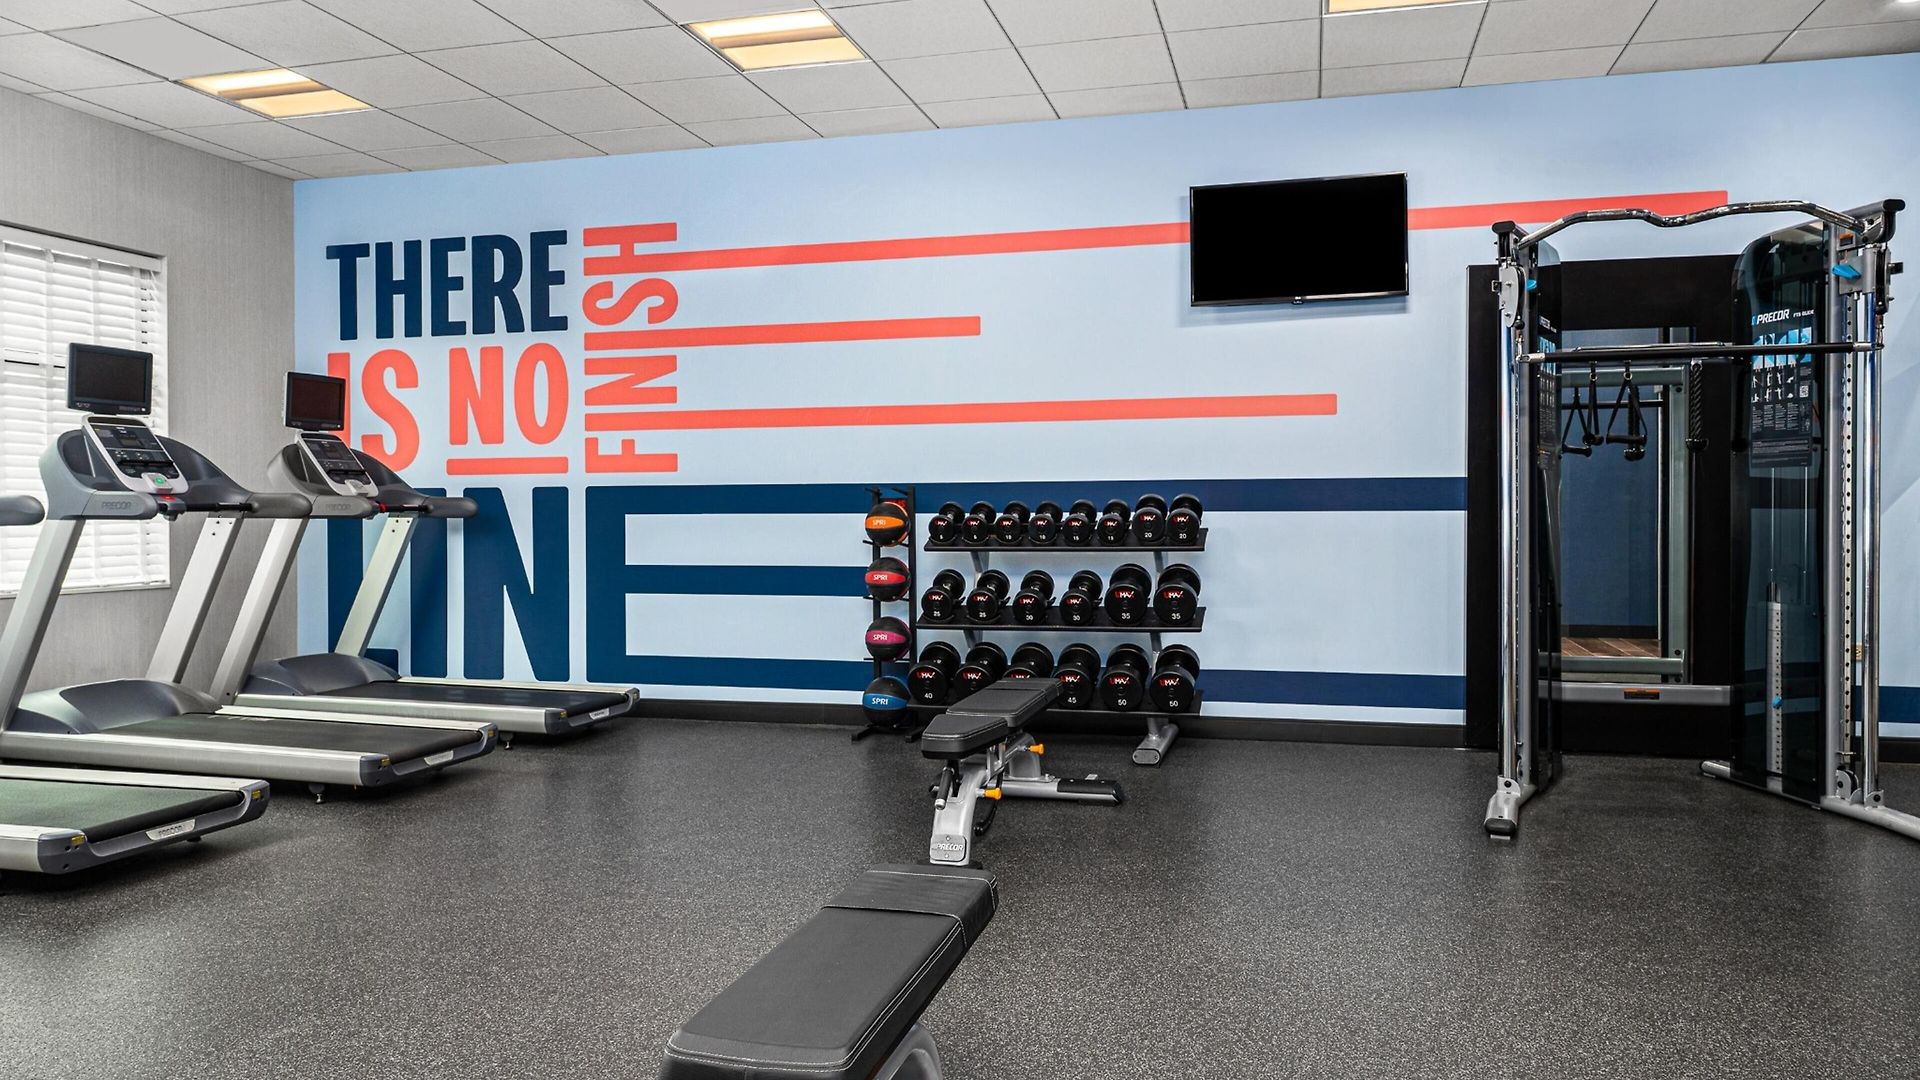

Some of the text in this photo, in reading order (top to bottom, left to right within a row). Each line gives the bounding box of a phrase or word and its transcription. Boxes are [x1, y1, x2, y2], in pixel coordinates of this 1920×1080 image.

[326, 229, 568, 340] THERE
[1756, 309, 1790, 325] PRECOR
[582, 222, 678, 473] FINISH
[449, 342, 569, 445] NO
[1121, 612, 1131, 620] 35
[1171, 612, 1182, 620] 35
[871, 697, 889, 705] SPRI
[937, 843, 964, 851] PRECOR
